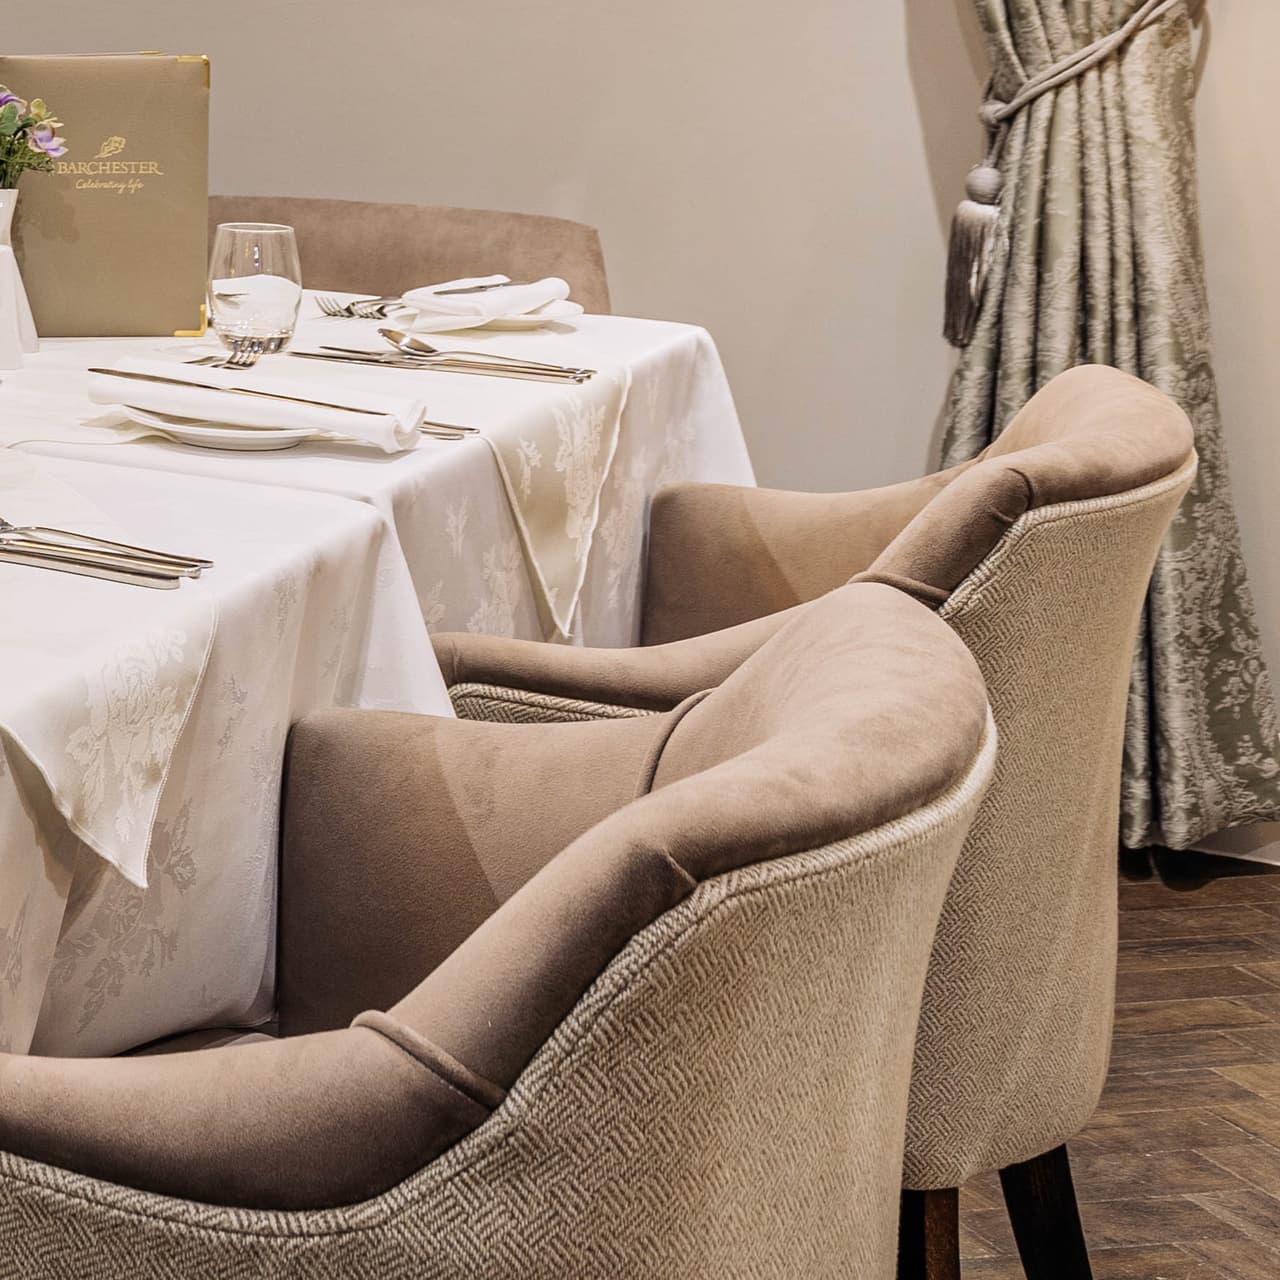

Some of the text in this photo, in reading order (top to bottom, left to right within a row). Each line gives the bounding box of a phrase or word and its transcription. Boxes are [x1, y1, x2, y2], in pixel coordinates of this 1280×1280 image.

[56, 161, 165, 176] BARCHESTER
[75, 177, 145, 194] Celebrating life
